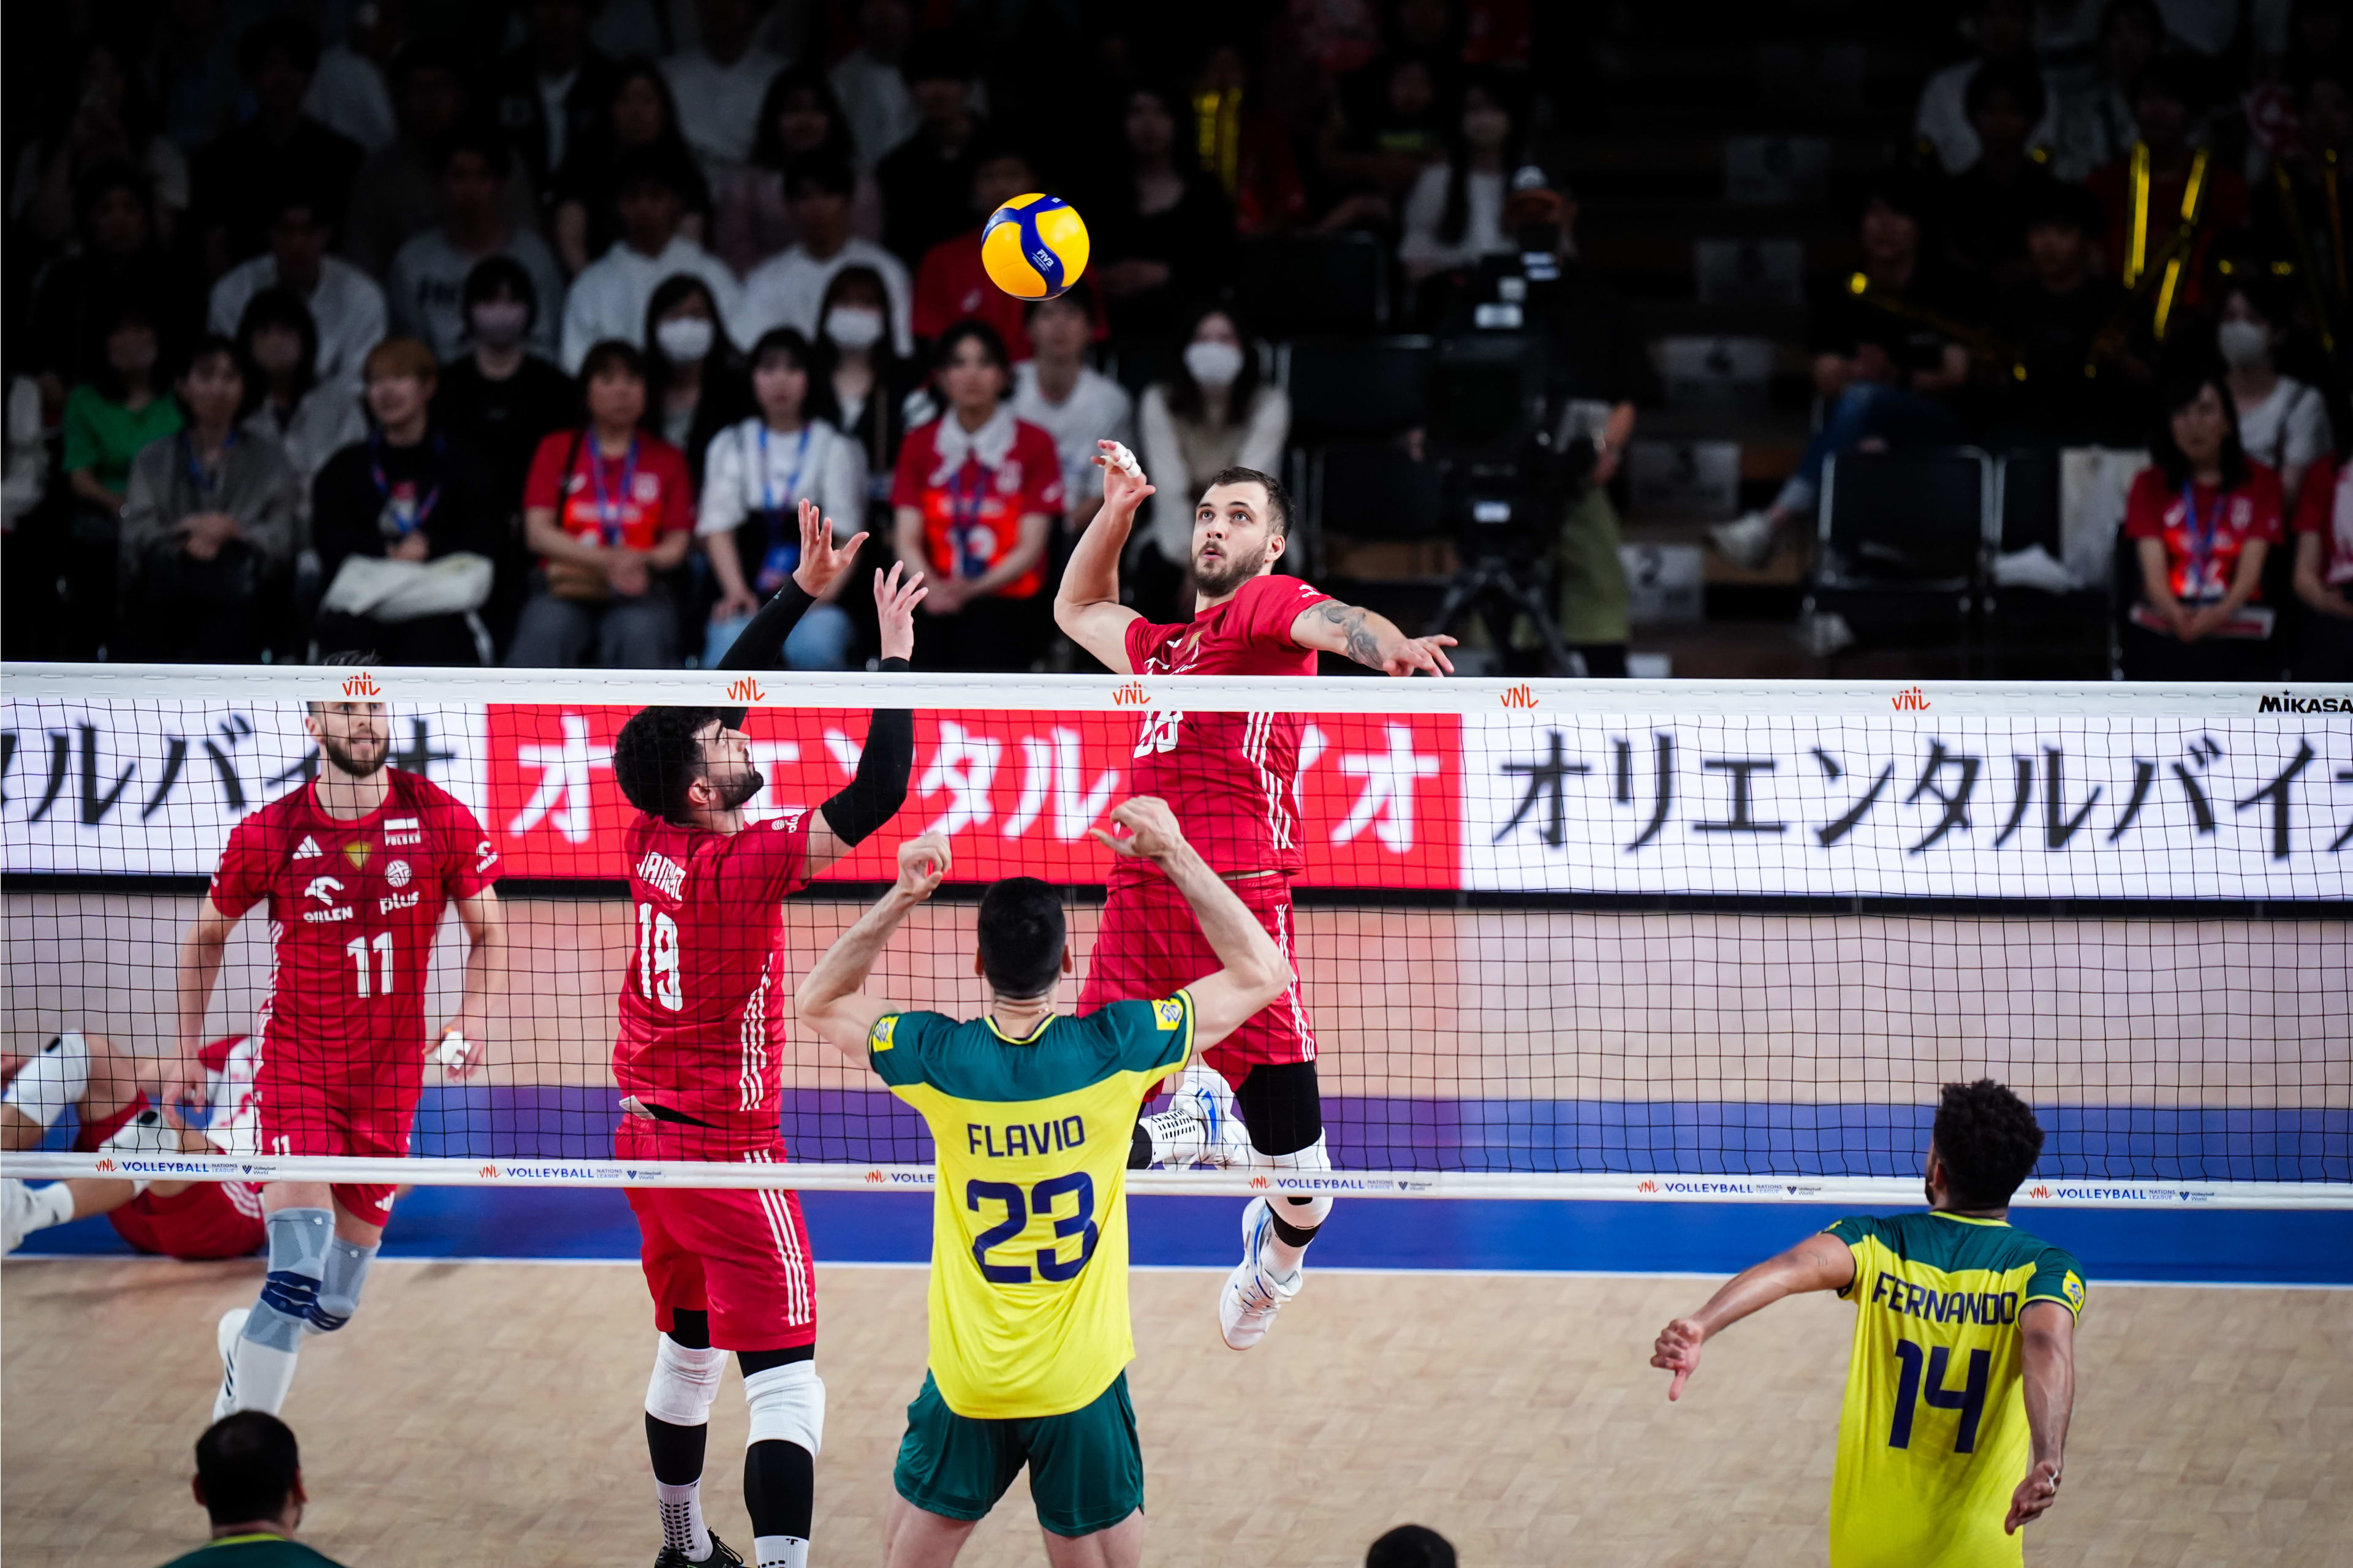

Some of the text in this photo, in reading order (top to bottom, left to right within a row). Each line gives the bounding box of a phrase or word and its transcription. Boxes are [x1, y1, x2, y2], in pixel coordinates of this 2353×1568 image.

[1036, 249, 1054, 267] FIVB
[342, 672, 381, 697] VNL
[727, 676, 765, 702] VNL
[1112, 681, 1151, 706] VNL
[1501, 683, 1539, 709] VNL
[1892, 686, 1931, 711] VNL
[303, 906, 354, 923] ORLEN
[380, 890, 420, 915] plus
[347, 931, 393, 998] 11
[638, 902, 684, 1012] 19
[271, 1135, 290, 1156] 11
[967, 1115, 1085, 1157] FLAVIO
[96, 1158, 210, 1172] VNL VOLLEYBALL
[479, 1164, 594, 1178] VNL VOLLEYBALL
[865, 1169, 934, 1183] VNL VOLLE
[1249, 1175, 1365, 1189] VNL VOLLEYBALL
[1637, 1180, 1753, 1193] VNL VOLLEYBALL
[2029, 1185, 2146, 1199] VNL VOLLEYBALL
[966, 1172, 1098, 1284] 23
[1872, 1271, 2018, 1326] FERNANDO
[1889, 1339, 1991, 1454] 14
